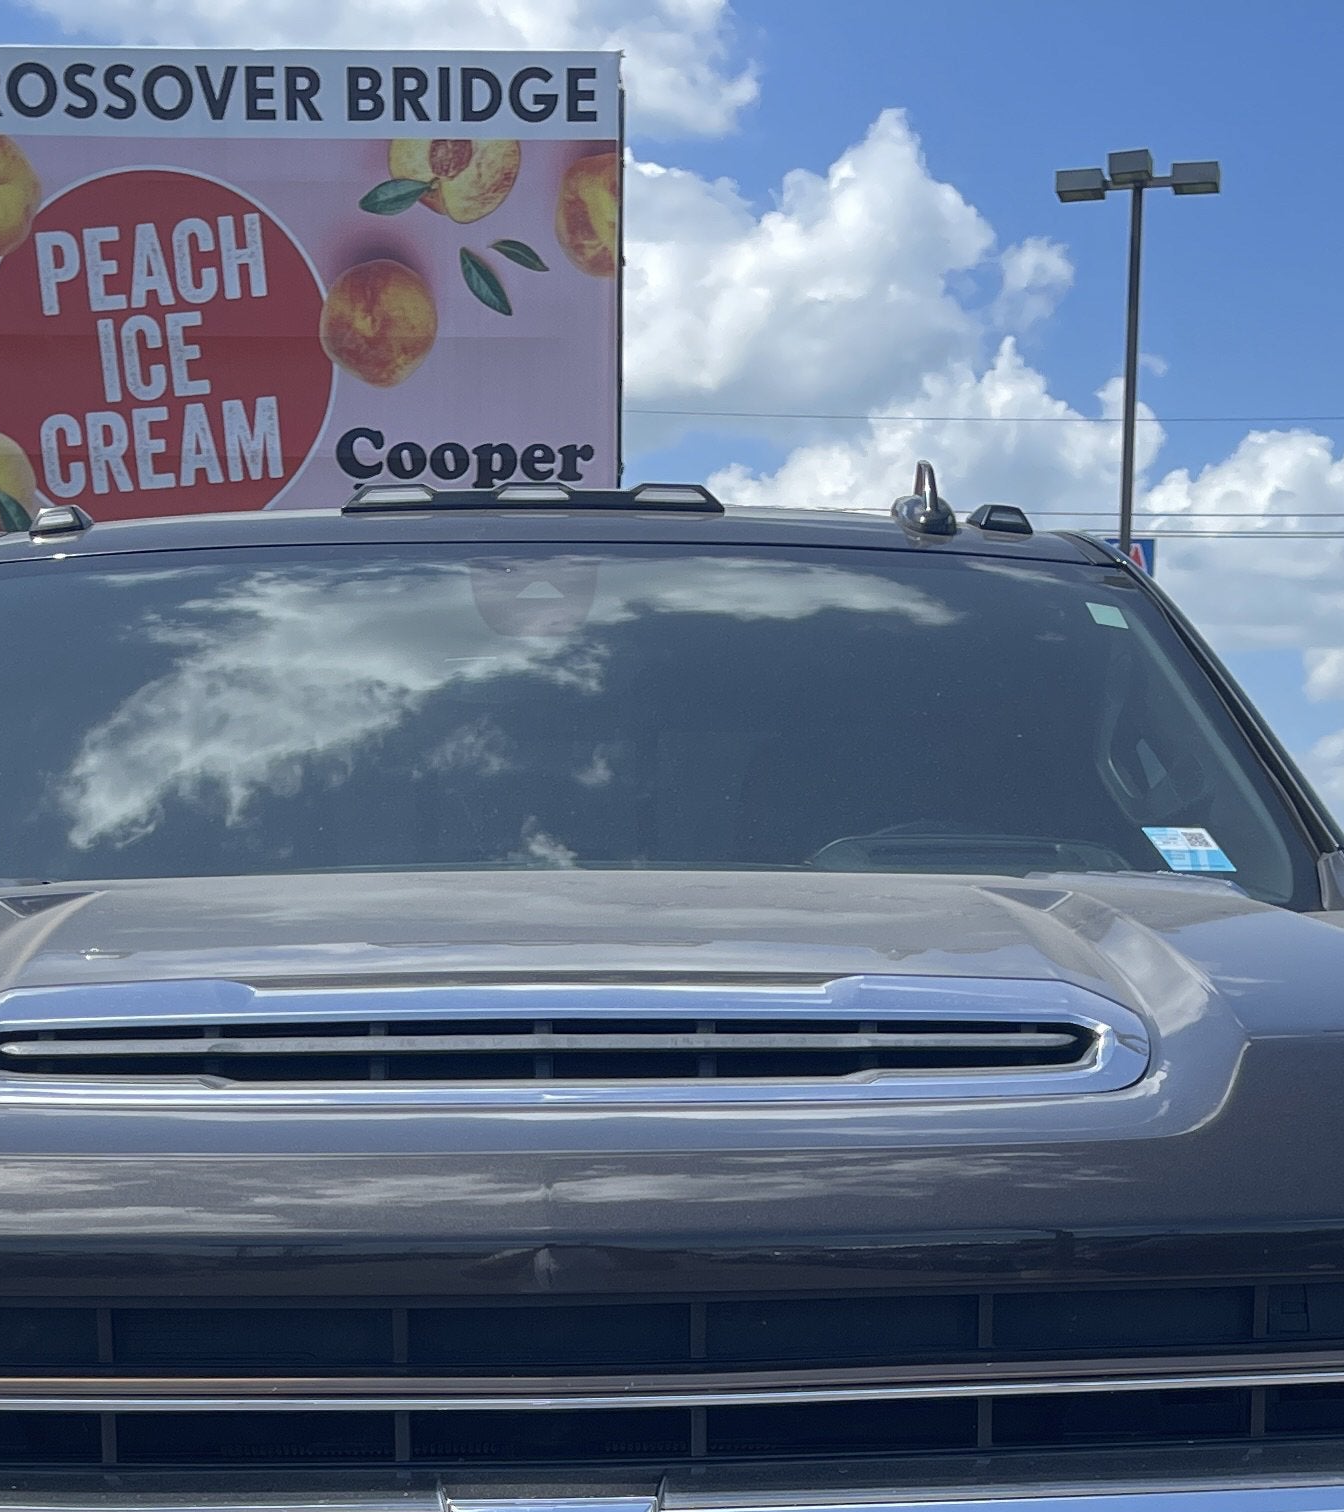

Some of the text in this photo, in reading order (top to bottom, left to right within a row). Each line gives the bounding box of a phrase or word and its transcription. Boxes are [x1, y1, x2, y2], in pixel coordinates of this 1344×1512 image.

[346, 65, 598, 123] BRIDGE
[34, 212, 268, 317] PEACH
[96, 310, 212, 403] ICE
[40, 395, 284, 499] CREAM
[335, 427, 595, 489] Cooper
